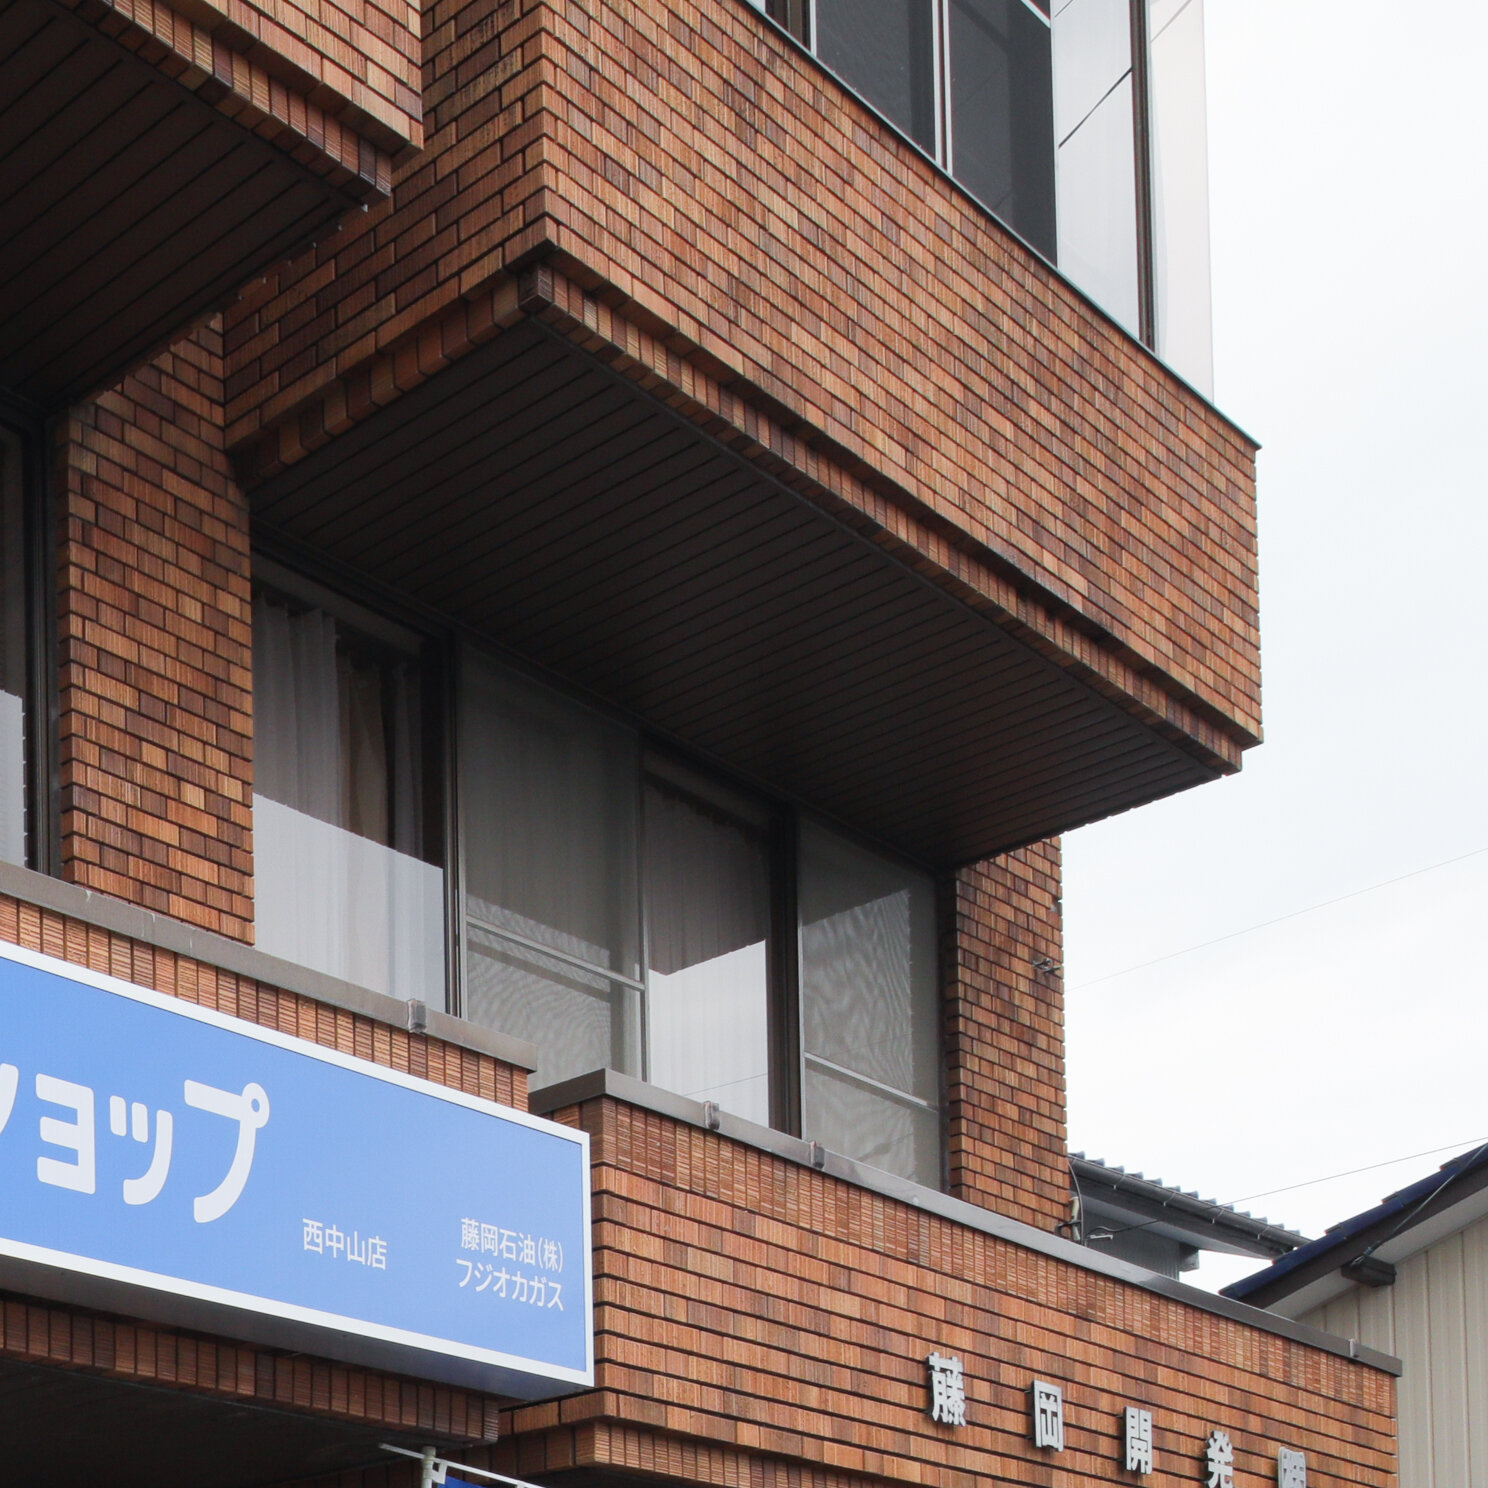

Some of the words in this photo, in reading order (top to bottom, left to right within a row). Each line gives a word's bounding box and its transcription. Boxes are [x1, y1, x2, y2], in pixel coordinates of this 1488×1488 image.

[302, 1218, 387, 1270] 西中山店
[461, 1217, 563, 1273] 藤岡石油(株)
[456, 1258, 564, 1311] フジオカガス
